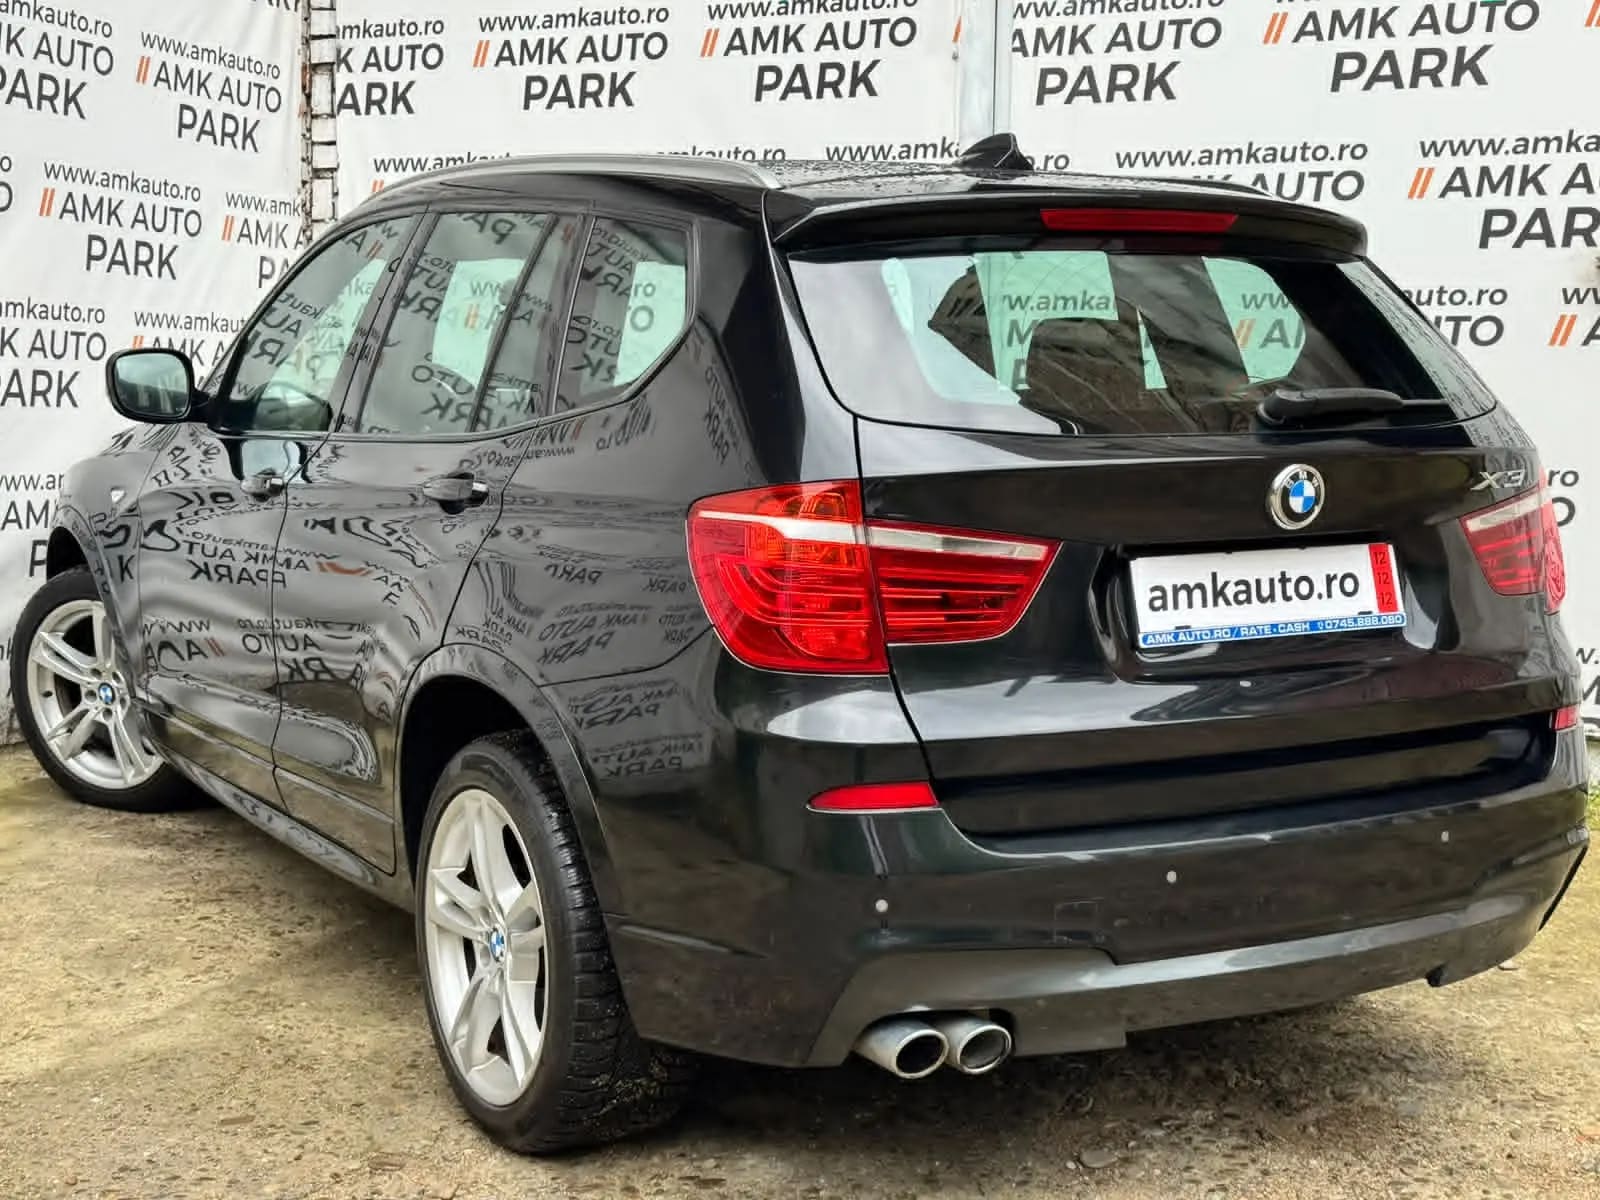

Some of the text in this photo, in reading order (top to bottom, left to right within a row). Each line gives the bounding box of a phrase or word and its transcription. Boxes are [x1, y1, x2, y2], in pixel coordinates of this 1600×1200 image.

[478, 7, 669, 32] www.amkauto.ro
[724, 17, 917, 57] AMK AUTO
[1012, 17, 1222, 57] AMK AUTO
[1292, 0, 1540, 43] AMK AUTO
[32, 31, 114, 76] AUTO
[141, 32, 280, 80] www.amkauto.ro
[361, 43, 444, 73] AUTO
[494, 32, 669, 68] AMK AUTO
[1330, 44, 1494, 92] PARK
[153, 61, 282, 113] AMK AUTO
[522, 71, 637, 110] PARK
[754, 59, 882, 102] PARK
[1035, 61, 1181, 105] PARK
[177, 103, 260, 153] PARK
[1115, 141, 1368, 168] www.amkauto.ro
[44, 161, 201, 202] www.amkauto.ro
[1438, 163, 1551, 199] AMK
[59, 191, 203, 238] AMK AUTO
[236, 217, 289, 249] AMK
[1478, 206, 1600, 249] PAR
[86, 234, 179, 280] PARK
[27, 328, 106, 362] AUTO
[1471, 471, 1525, 491] X3
[1373, 552, 1386, 565] 12
[1377, 572, 1390, 585] 12
[1148, 571, 1360, 612] amkauto.ro
[1380, 592, 1393, 606] 12
[1146, 633, 1175, 645] AMK
[1177, 629, 1231, 643] AUTO.RO
